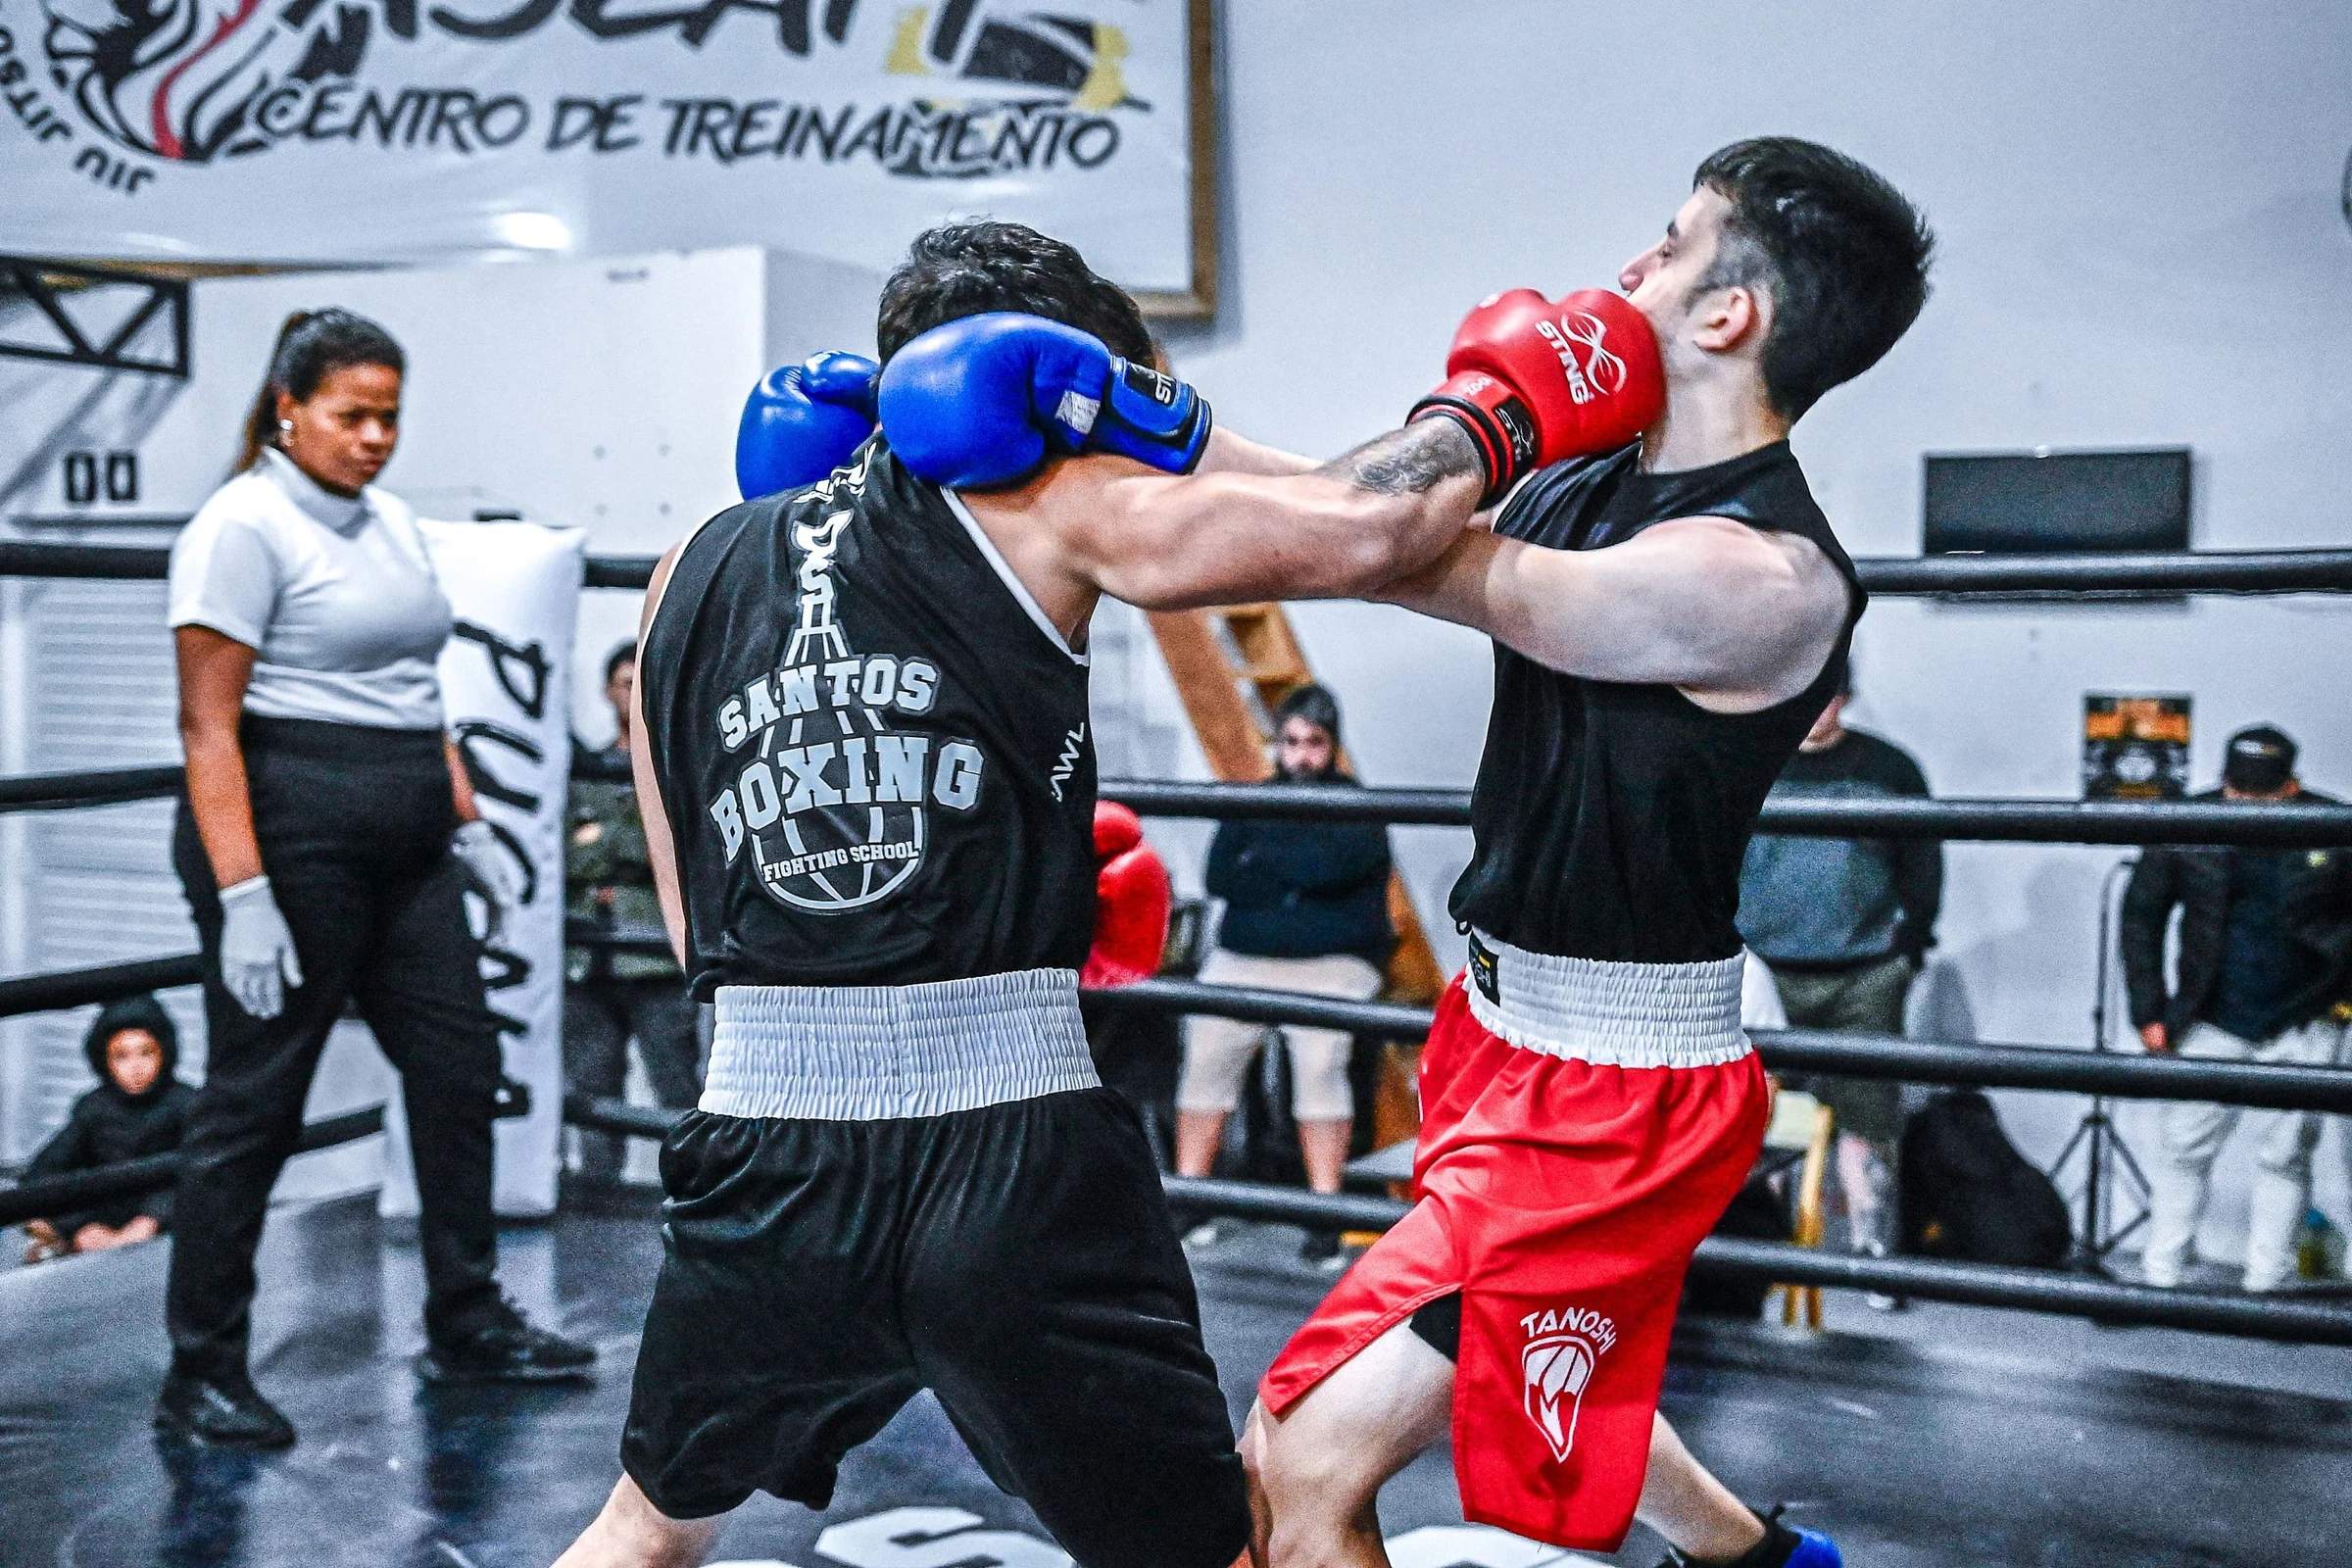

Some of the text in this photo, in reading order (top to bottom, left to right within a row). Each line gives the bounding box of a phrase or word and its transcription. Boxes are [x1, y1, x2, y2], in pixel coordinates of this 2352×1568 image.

[257, 82, 1121, 169] CENTRO DE TREINAMENTO
[73, 145, 156, 194] JIU
[1534, 319, 1591, 406] STING
[718, 656, 940, 750] SANTOS
[710, 735, 985, 863] BOXING
[762, 840, 920, 883] FIGHTING SCHOOL
[1519, 1306, 1617, 1356] TANOSHI
